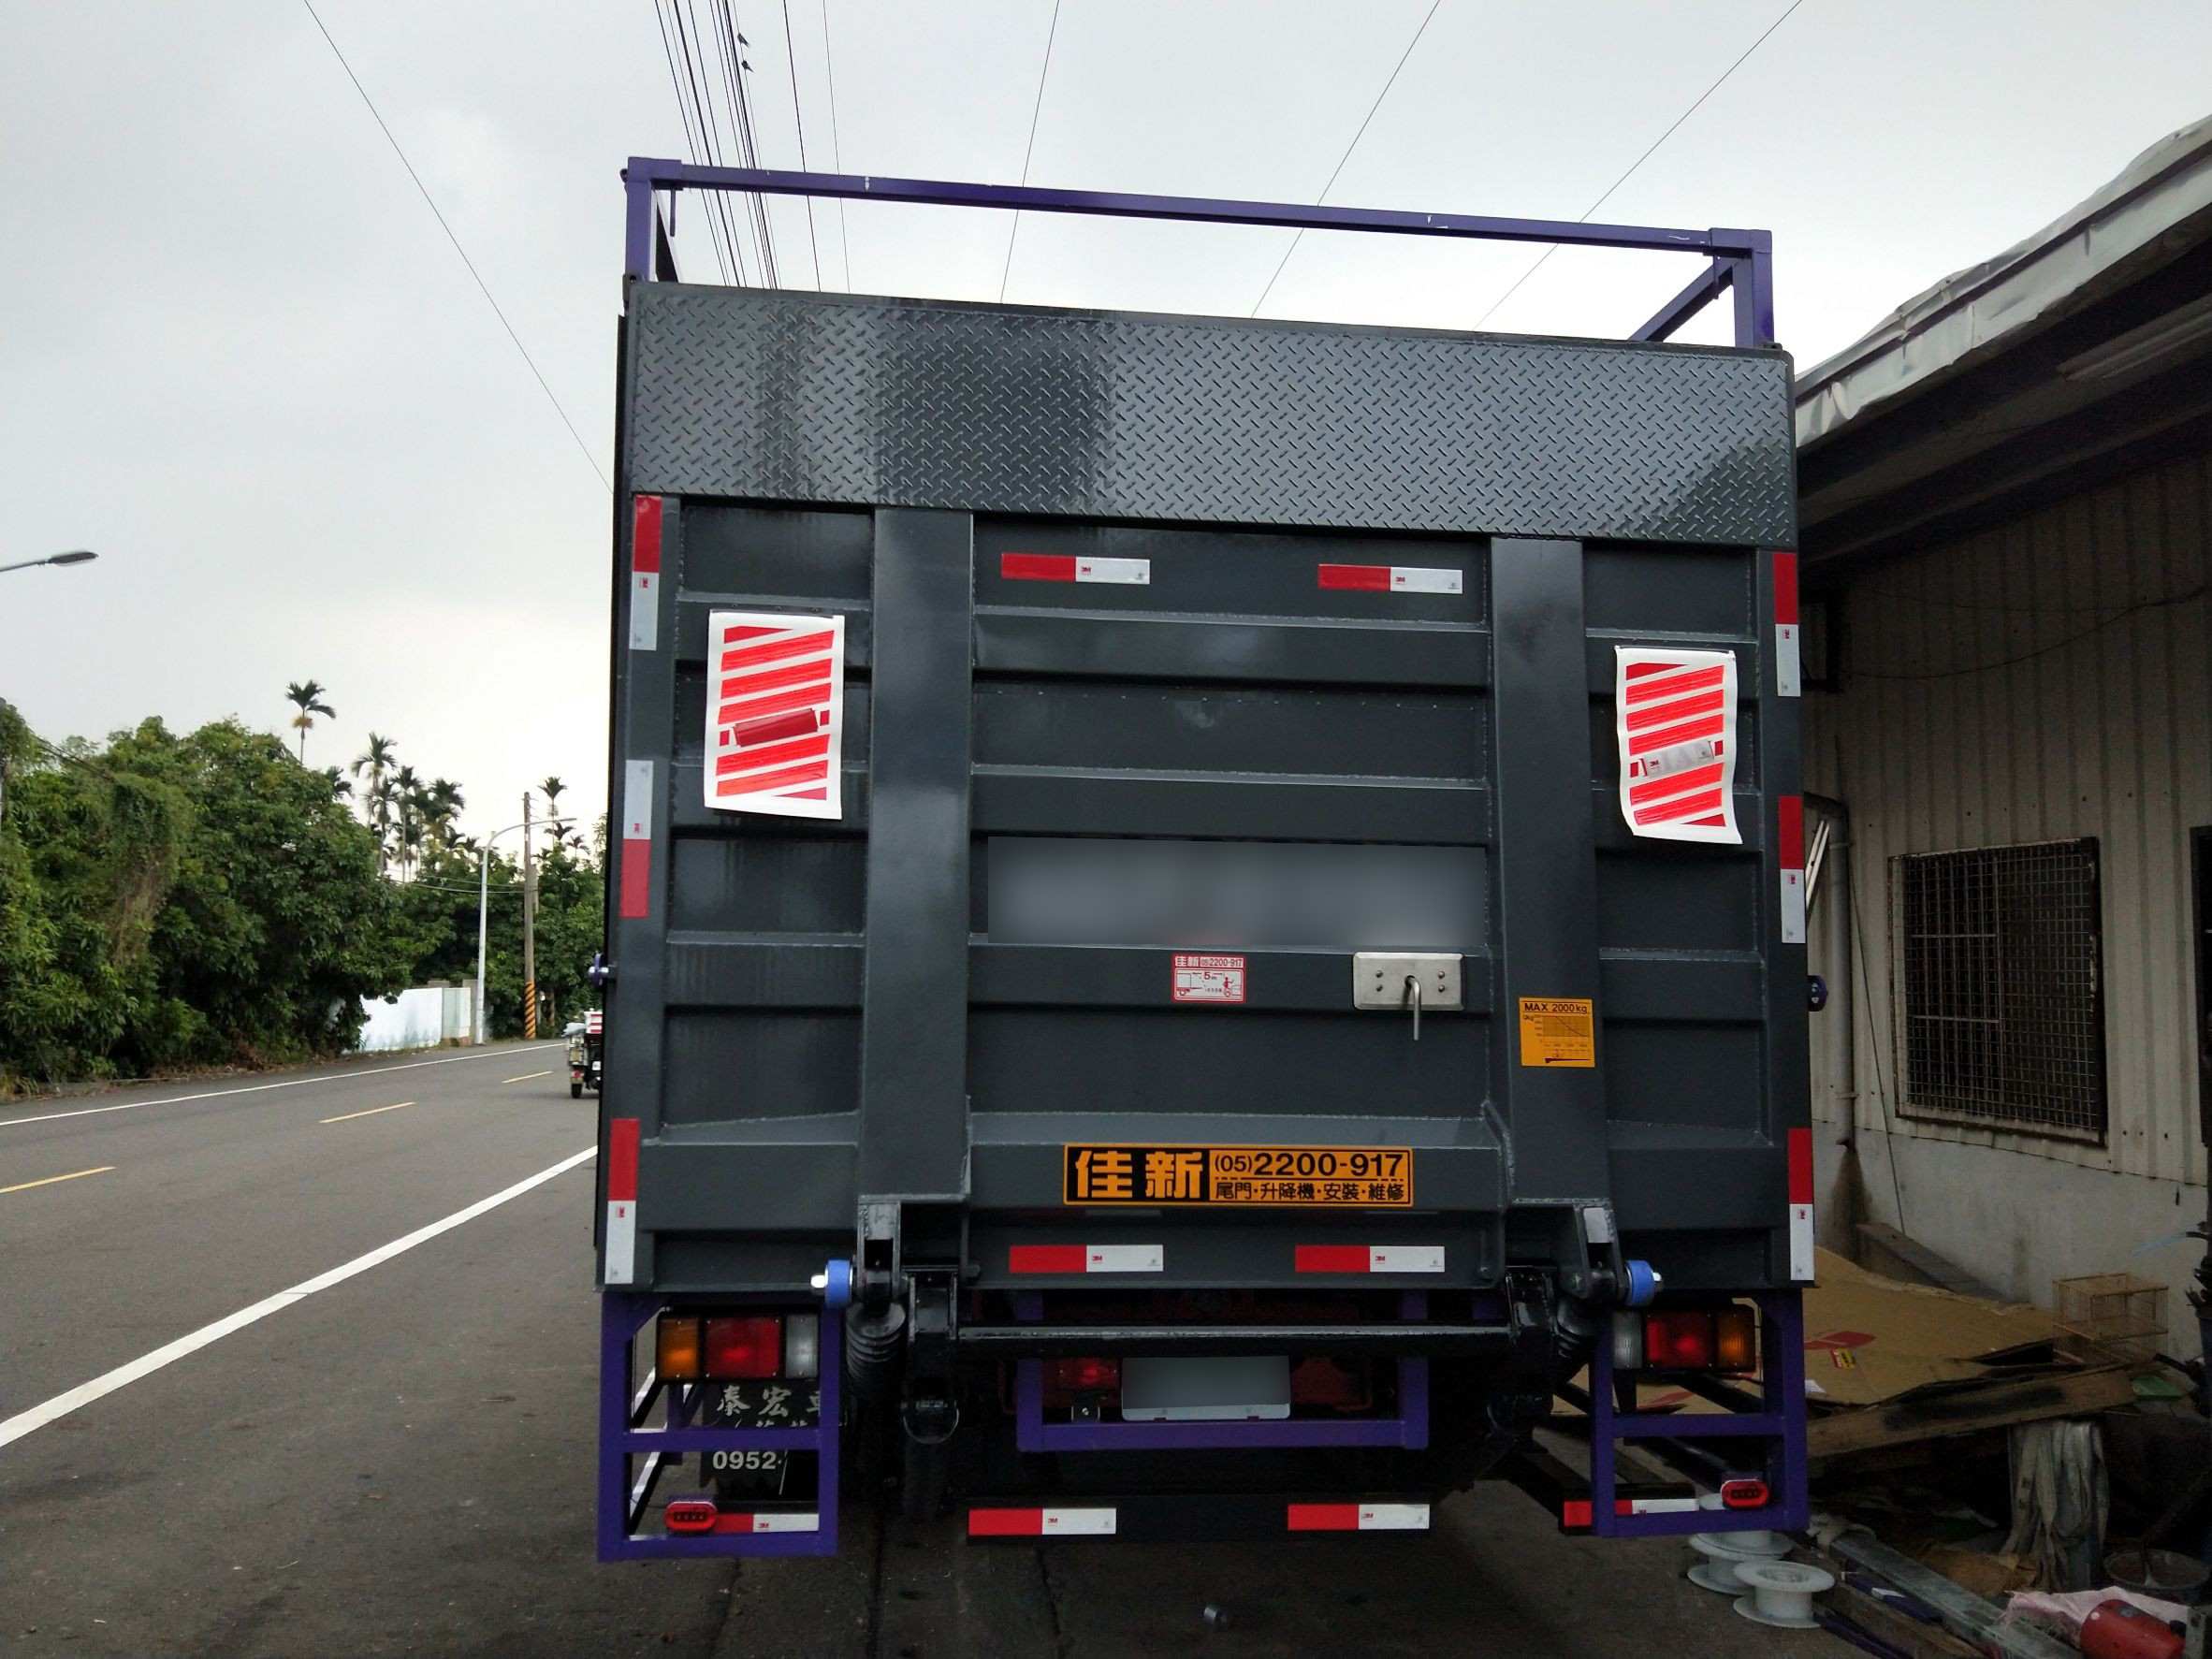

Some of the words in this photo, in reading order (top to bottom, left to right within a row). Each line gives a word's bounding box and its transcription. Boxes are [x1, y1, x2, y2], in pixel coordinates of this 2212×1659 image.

[1524, 1002, 1549, 1011] MAX
[1552, 1003, 1588, 1014] 2000kg
[1075, 1150, 1203, 1199] 佳新
